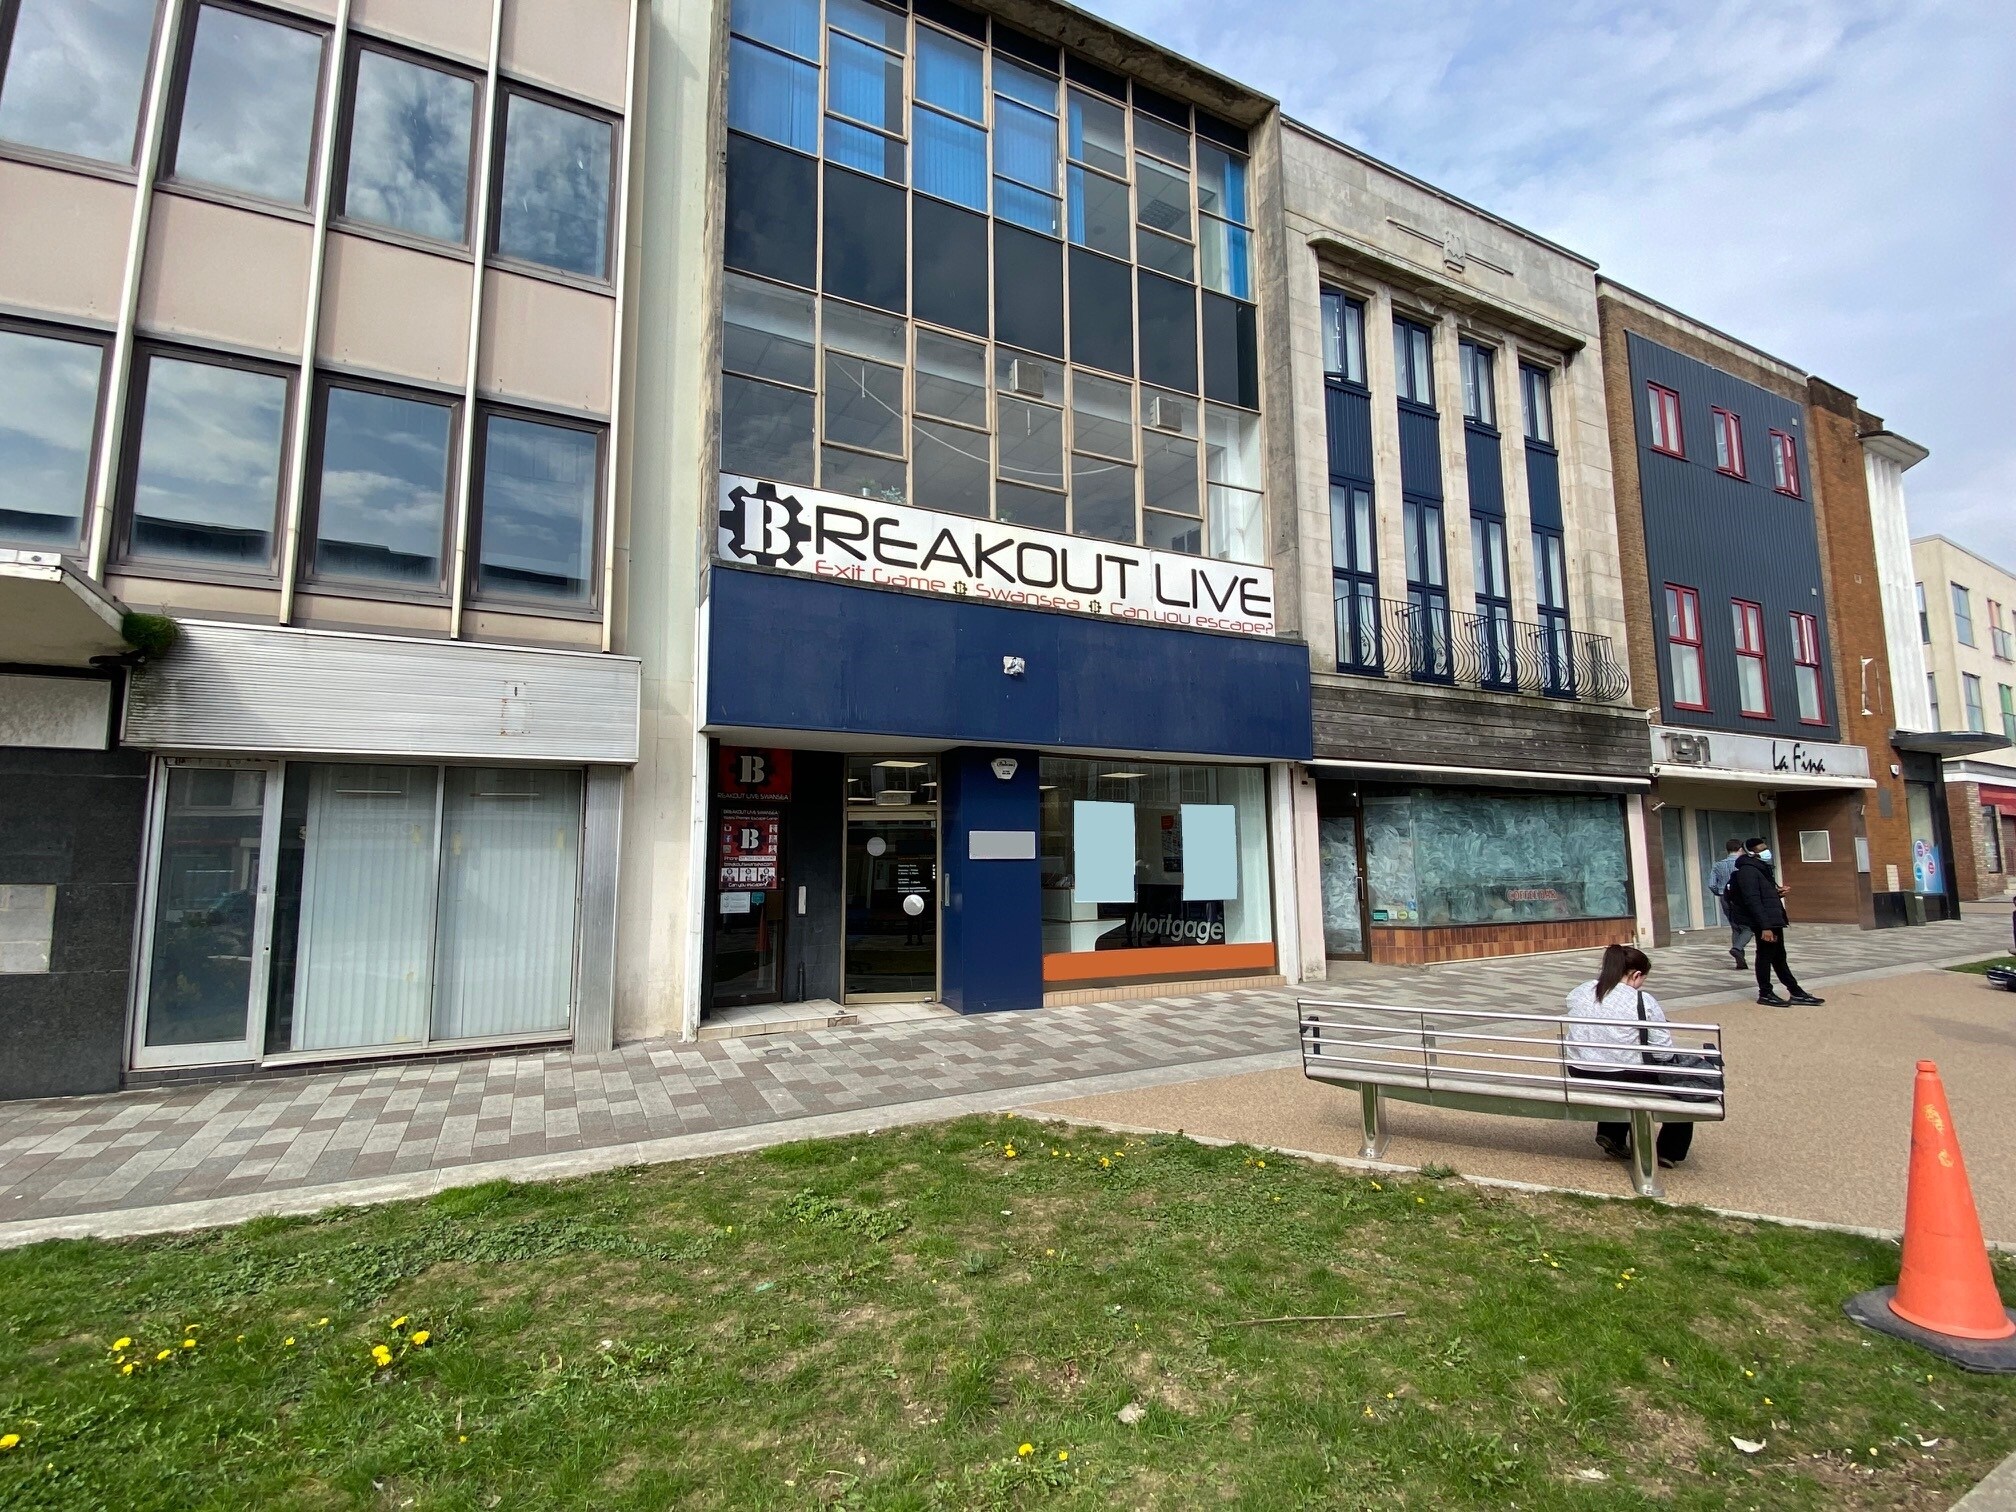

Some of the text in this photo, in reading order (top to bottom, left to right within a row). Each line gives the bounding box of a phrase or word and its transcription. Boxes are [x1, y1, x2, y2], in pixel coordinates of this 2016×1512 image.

[815, 560, 865, 581] Exit
[872, 568, 946, 592] Game
[976, 583, 1080, 611] Swansea
[1110, 602, 1149, 620] Can
[1154, 610, 1191, 625] you
[1195, 616, 1274, 634] escape?
[1155, 564, 1272, 618] LIVE
[1131, 912, 1224, 944] Mortgage
